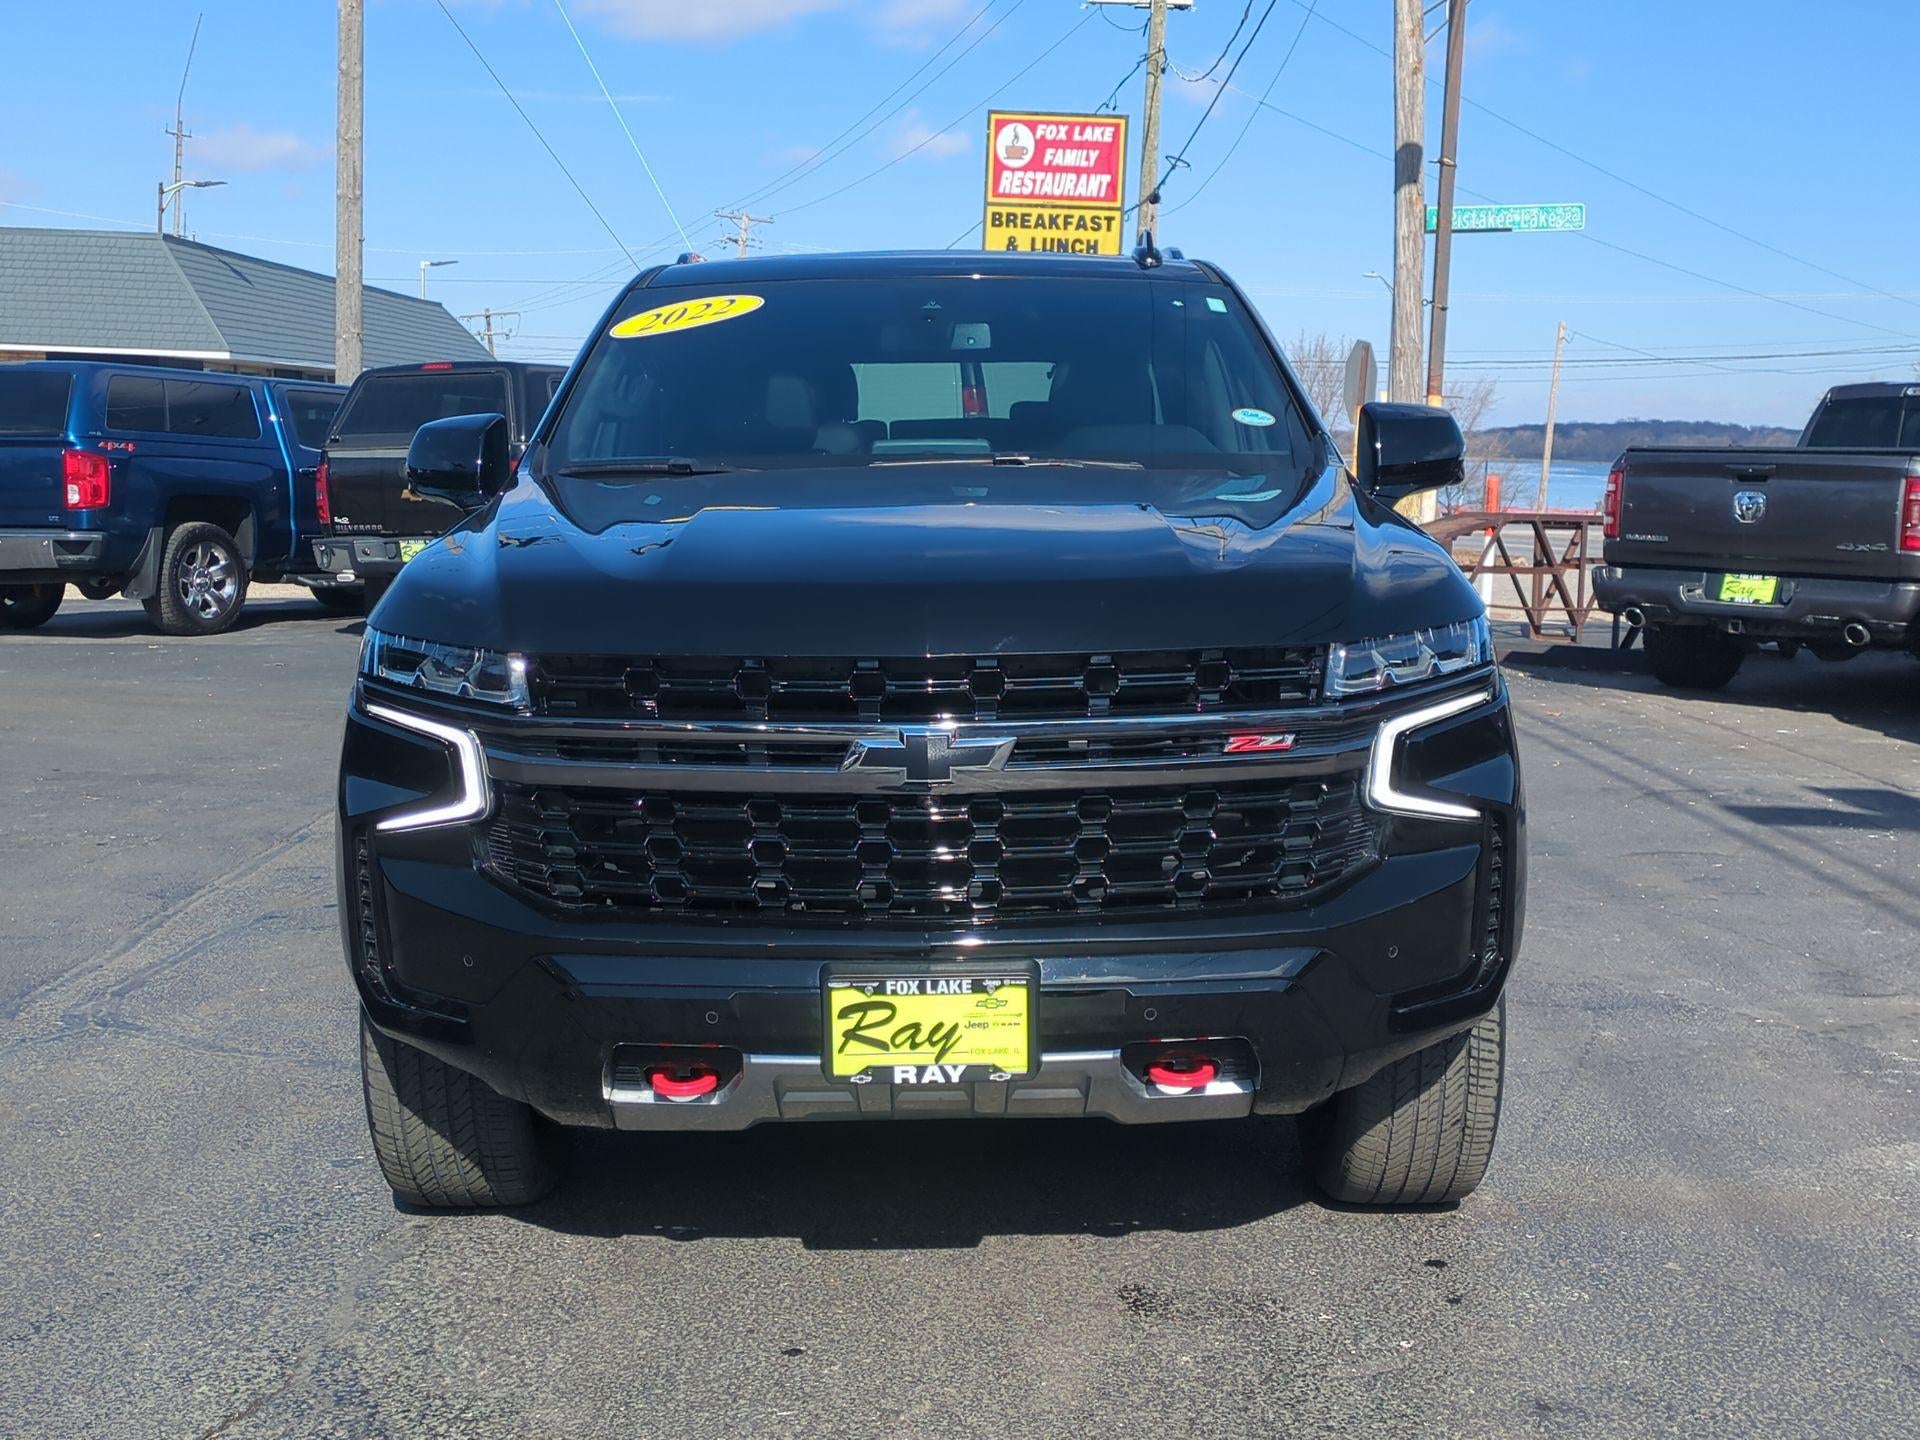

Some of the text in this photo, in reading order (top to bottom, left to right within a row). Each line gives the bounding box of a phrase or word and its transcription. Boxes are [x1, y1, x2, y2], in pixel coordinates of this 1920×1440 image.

[1036, 125, 1115, 142] FOX LAKE
[1043, 148, 1100, 168] FAMILY
[998, 170, 1112, 198] RESTAURANT
[991, 211, 1115, 232] BREAKFAST
[1521, 208, 1556, 227] Lake
[1006, 235, 1099, 254] & LUNCH
[635, 298, 737, 333] 2022
[1223, 733, 1296, 753] Z71
[886, 979, 972, 995] FOX LAKE
[837, 1000, 962, 1064] Ray
[964, 1020, 989, 1030] Jeep
[894, 1065, 967, 1084] RAY
